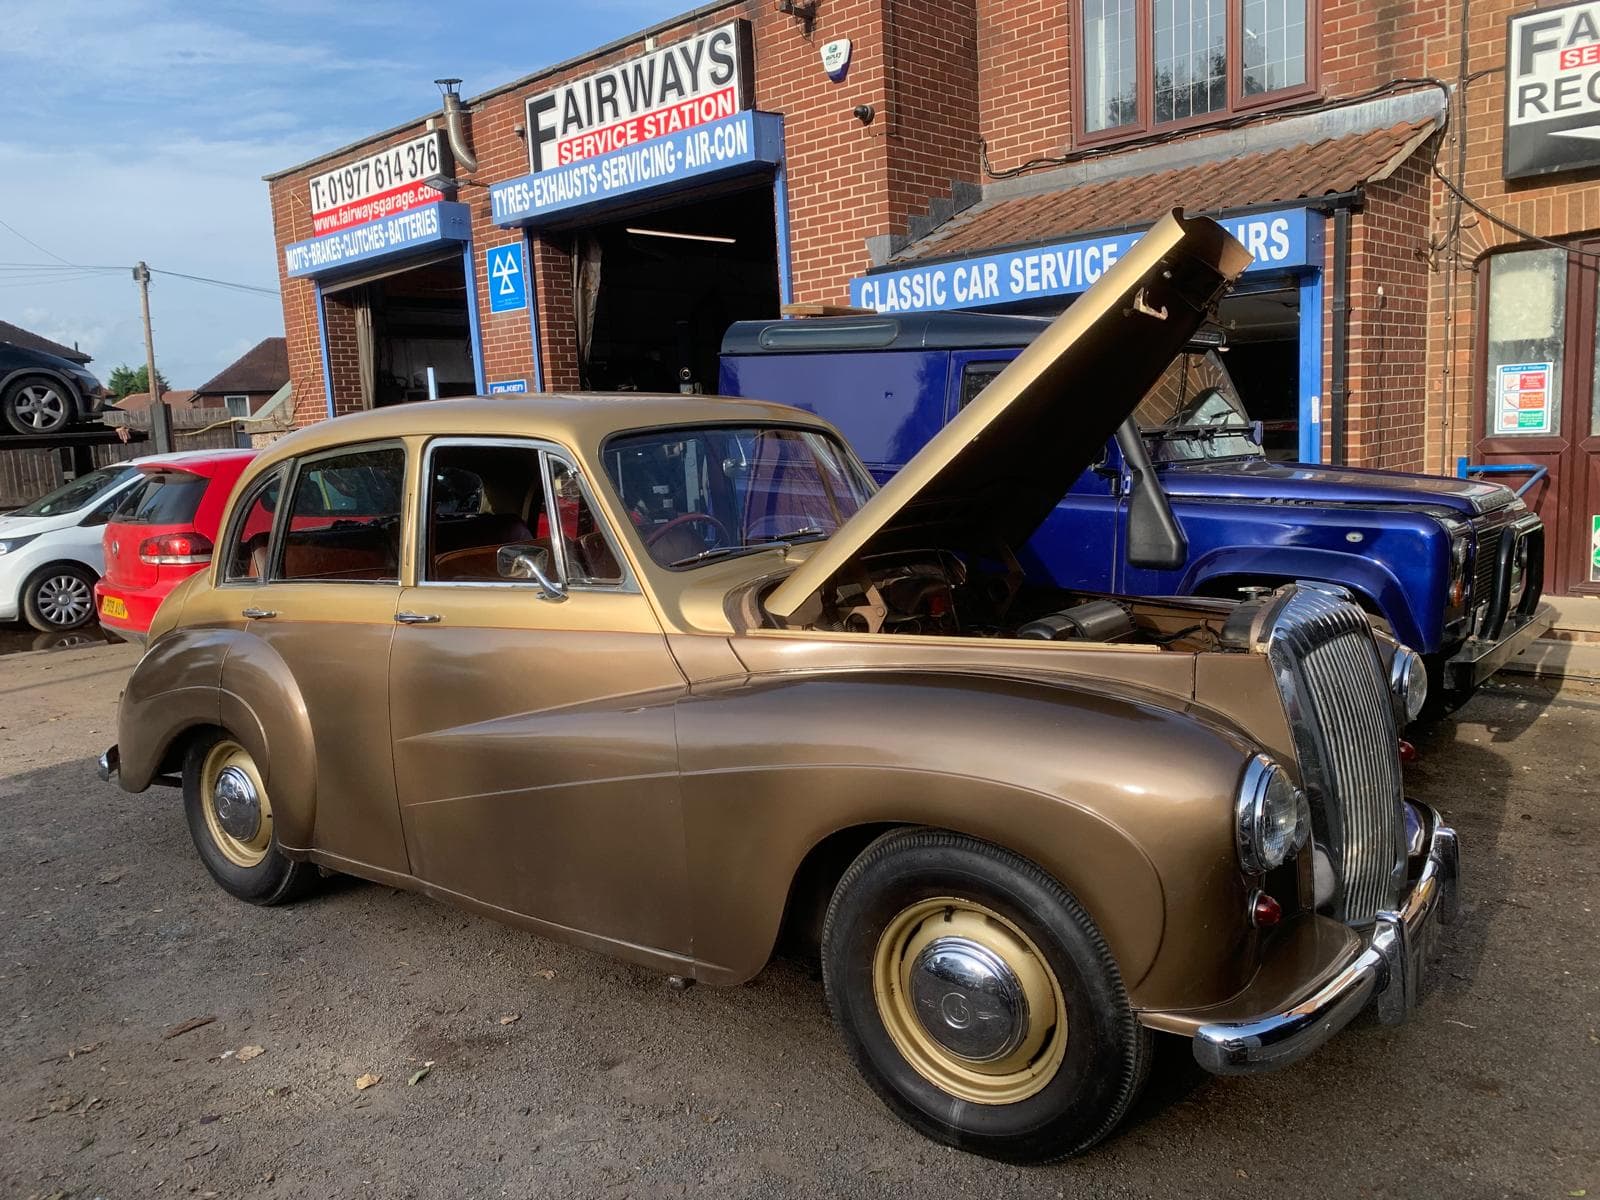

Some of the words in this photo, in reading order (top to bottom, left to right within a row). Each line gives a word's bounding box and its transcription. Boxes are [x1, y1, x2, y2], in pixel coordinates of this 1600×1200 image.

[528, 32, 734, 172] FAIRWAYS
[560, 120, 638, 165] SERVICE
[643, 90, 733, 139] STATION
[312, 182, 327, 210] T:
[328, 162, 370, 205] 01977
[375, 151, 403, 189] 614
[407, 138, 437, 178] 376
[685, 119, 748, 169] AIR-CON
[388, 207, 438, 245] BATTERIES
[861, 270, 947, 312] CLASSIC
[953, 262, 1000, 302] CAR
